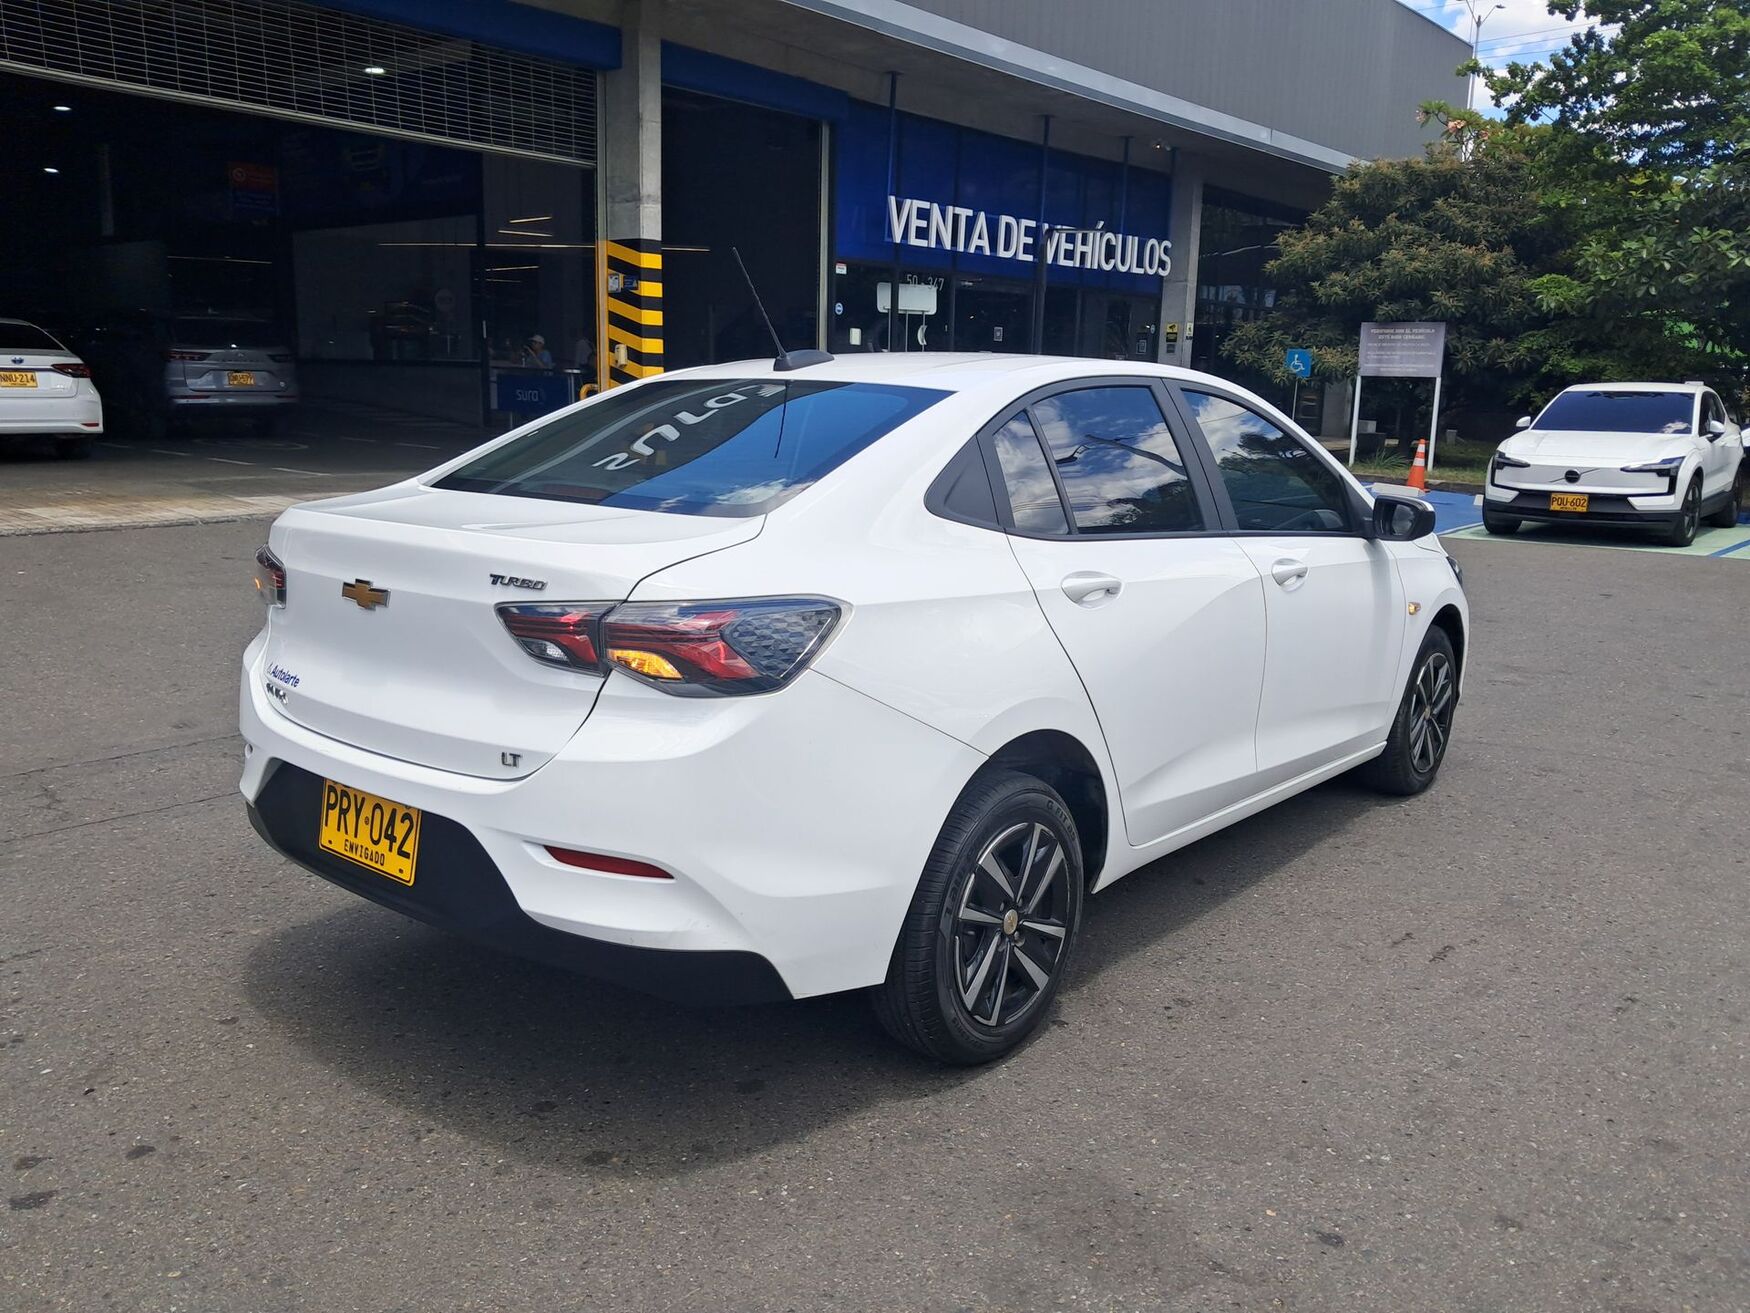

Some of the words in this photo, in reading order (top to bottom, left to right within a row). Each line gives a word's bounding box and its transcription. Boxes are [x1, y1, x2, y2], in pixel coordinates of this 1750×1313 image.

[888, 195, 991, 257] VENTA
[996, 214, 1037, 262] DE
[1041, 219, 1172, 277] VEHÍCULOS
[515, 389, 539, 402] sura
[489, 573, 548, 591] TURBO
[501, 752, 521, 768] LT
[344, 839, 386, 867] ENVIGADO
